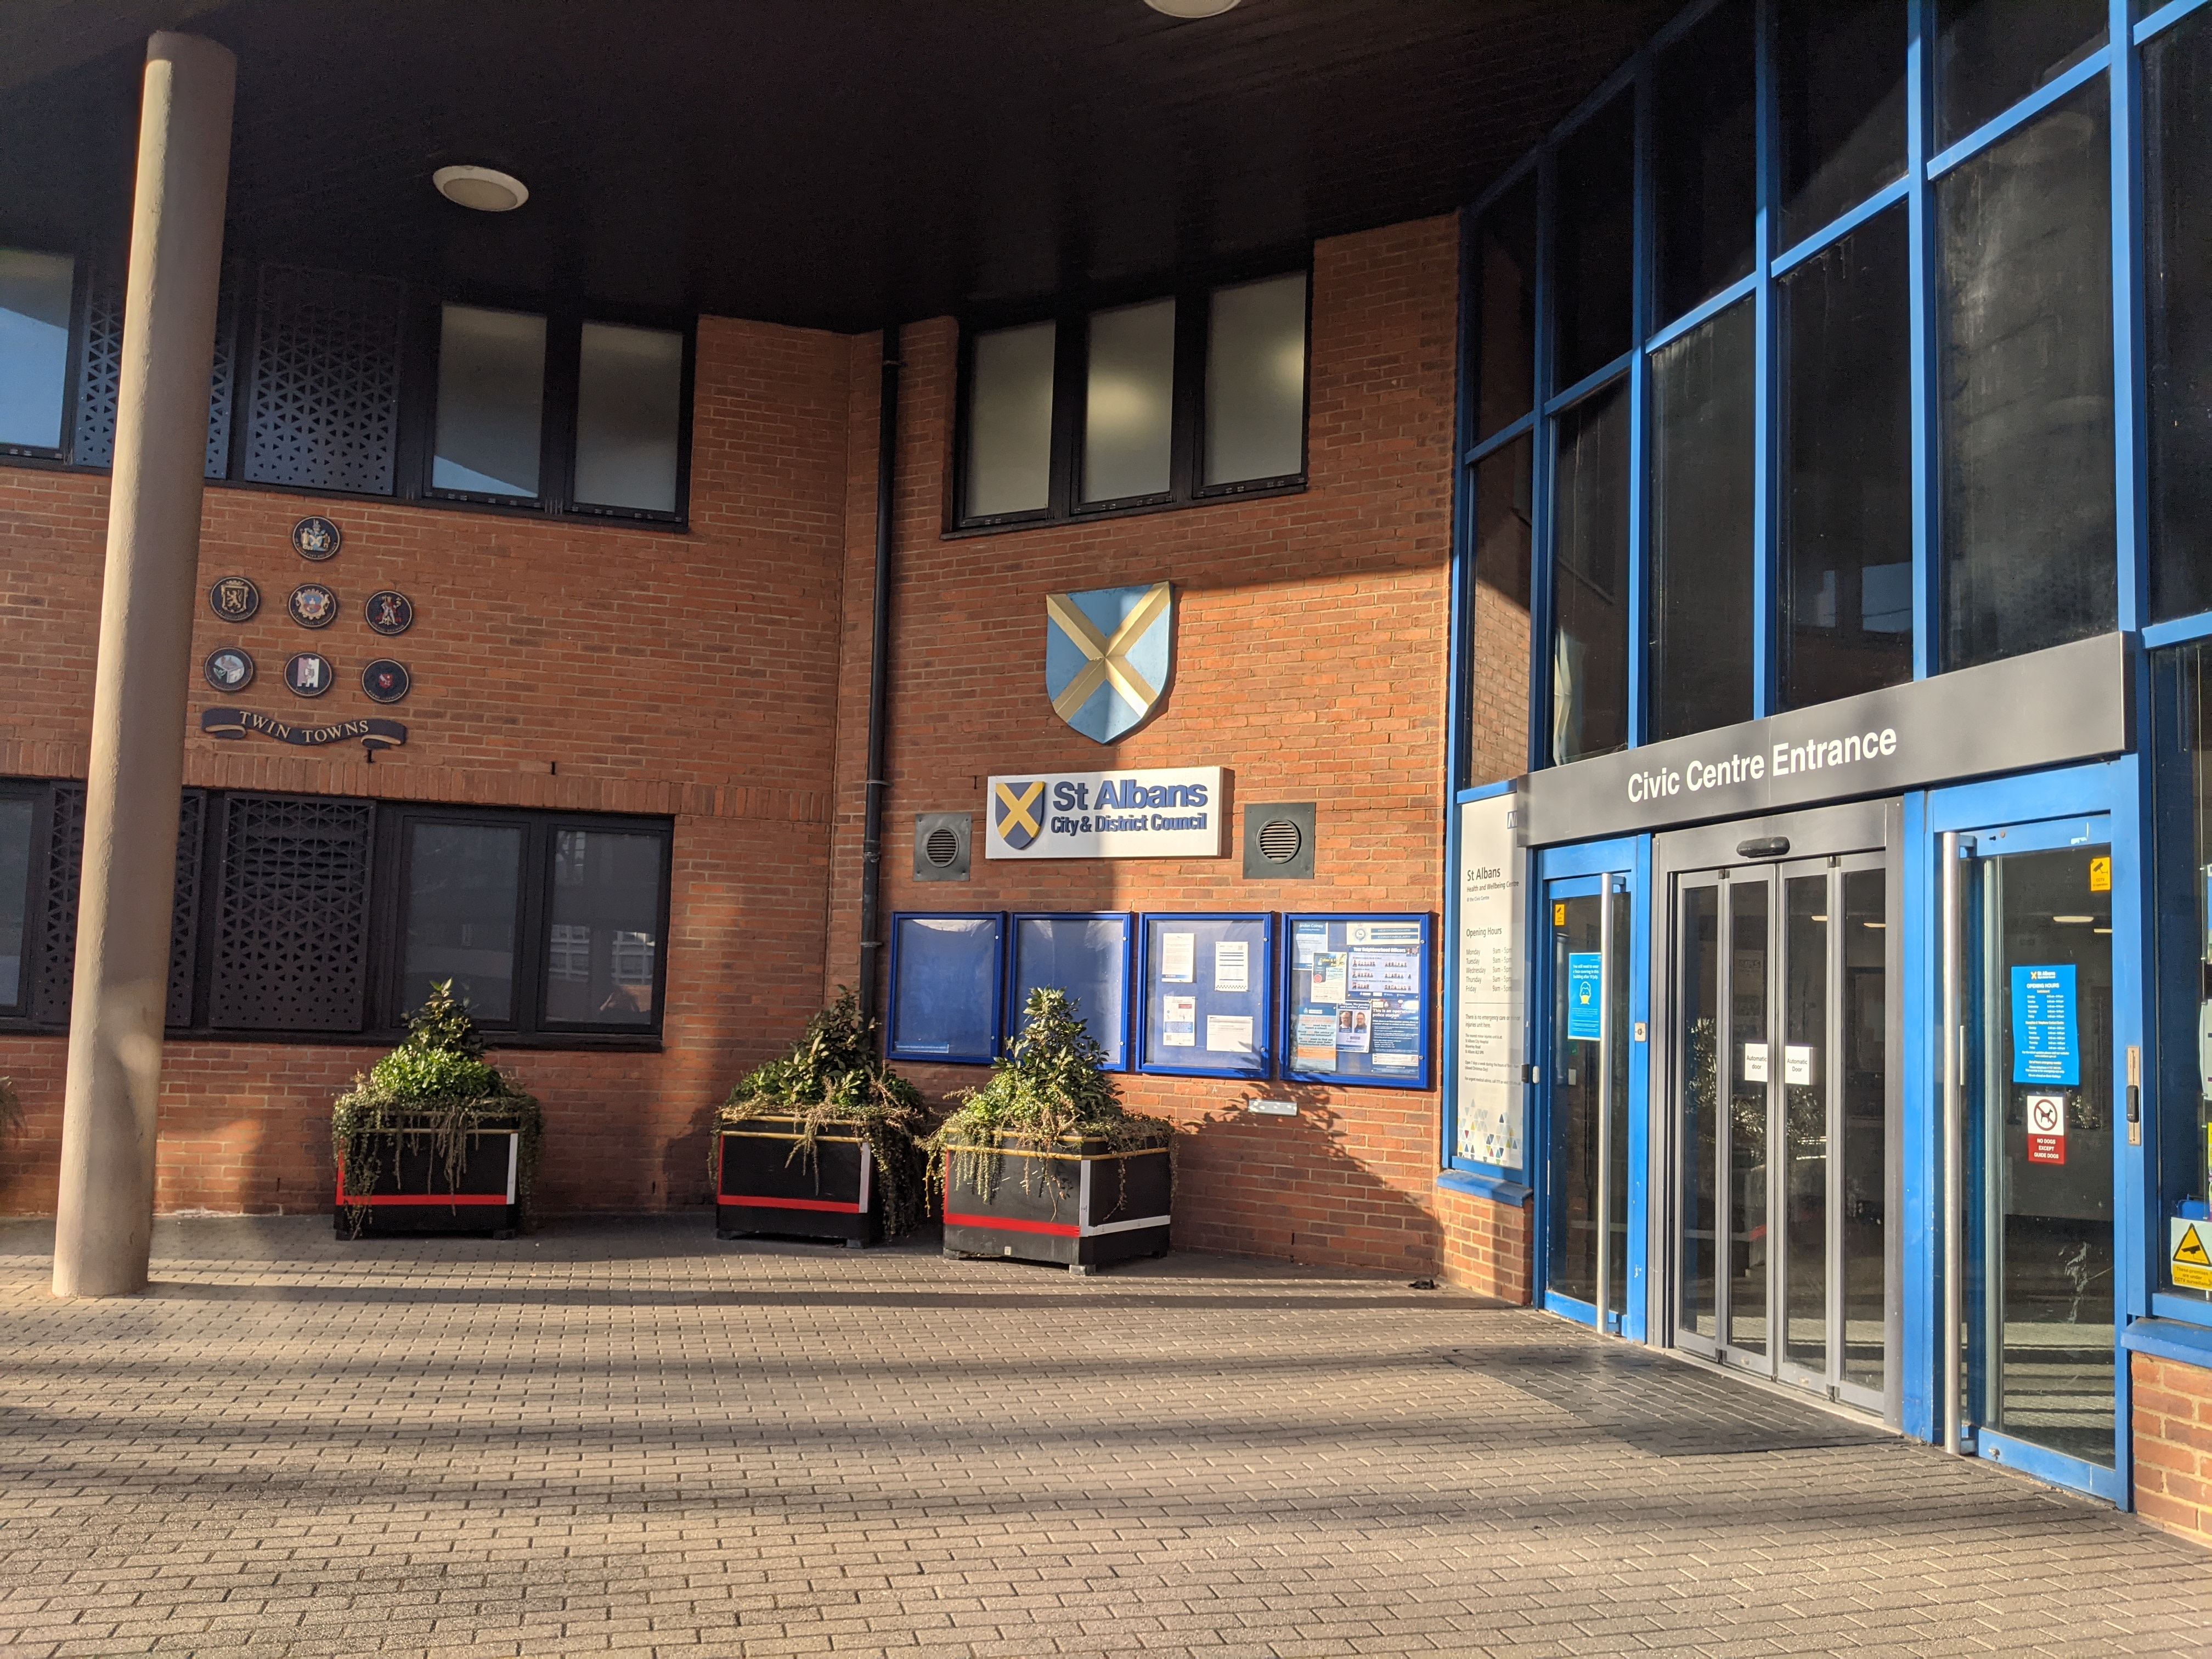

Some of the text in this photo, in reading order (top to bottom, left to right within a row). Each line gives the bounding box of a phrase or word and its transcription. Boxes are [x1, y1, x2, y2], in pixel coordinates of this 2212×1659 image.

[239, 711, 369, 742] TWIN TOWNS
[1628, 727, 1897, 803] Civic Centre Entrance
[1052, 779, 1208, 811] St Albans
[1051, 812, 1207, 837] City & District Council
[1467, 866, 1500, 882] St Albans
[1487, 882, 1505, 890] Wellbeing
[1466, 927, 1502, 939] Opening Hours
[1466, 948, 1481, 957] Monday
[1466, 957, 1480, 966] Tuesday
[1465, 966, 1486, 975] Wednesday
[1465, 976, 1482, 984] Thursday
[1465, 985, 1477, 994] Friday
